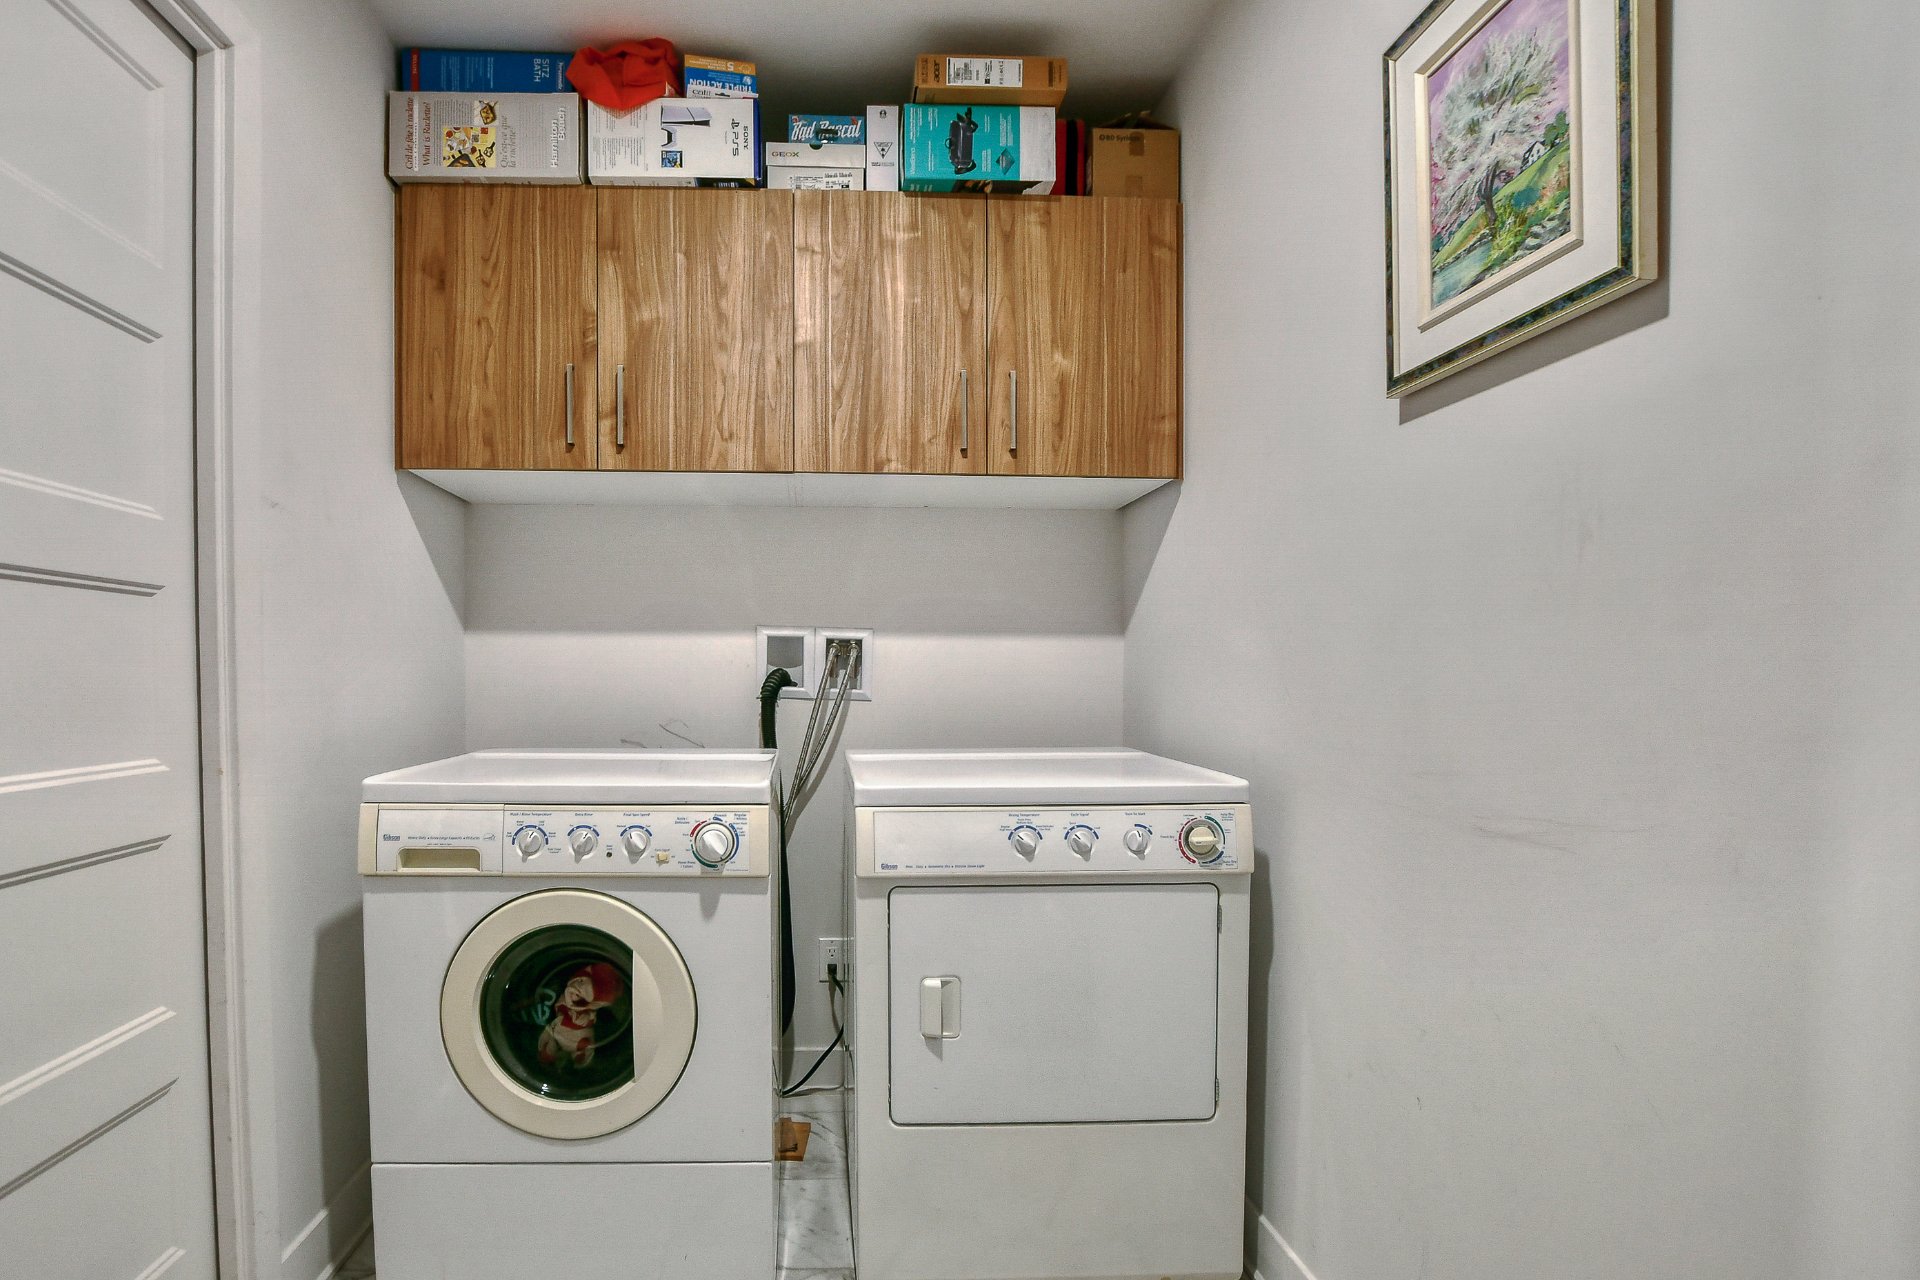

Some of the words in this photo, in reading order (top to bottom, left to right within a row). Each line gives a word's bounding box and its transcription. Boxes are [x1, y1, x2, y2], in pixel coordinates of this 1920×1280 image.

[533, 58, 542, 83] BATH
[541, 58, 550, 78] SITZ
[726, 61, 735, 72] 5
[933, 60, 941, 83] acer
[689, 78, 724, 90] ACTION
[724, 82, 753, 93] TRIPLE
[422, 101, 431, 134] Raclette?
[557, 105, 566, 141] Beach
[550, 119, 559, 168] Hamilton
[732, 131, 740, 156] PS5
[422, 145, 431, 166] What
[383, 833, 401, 841] Gibson
